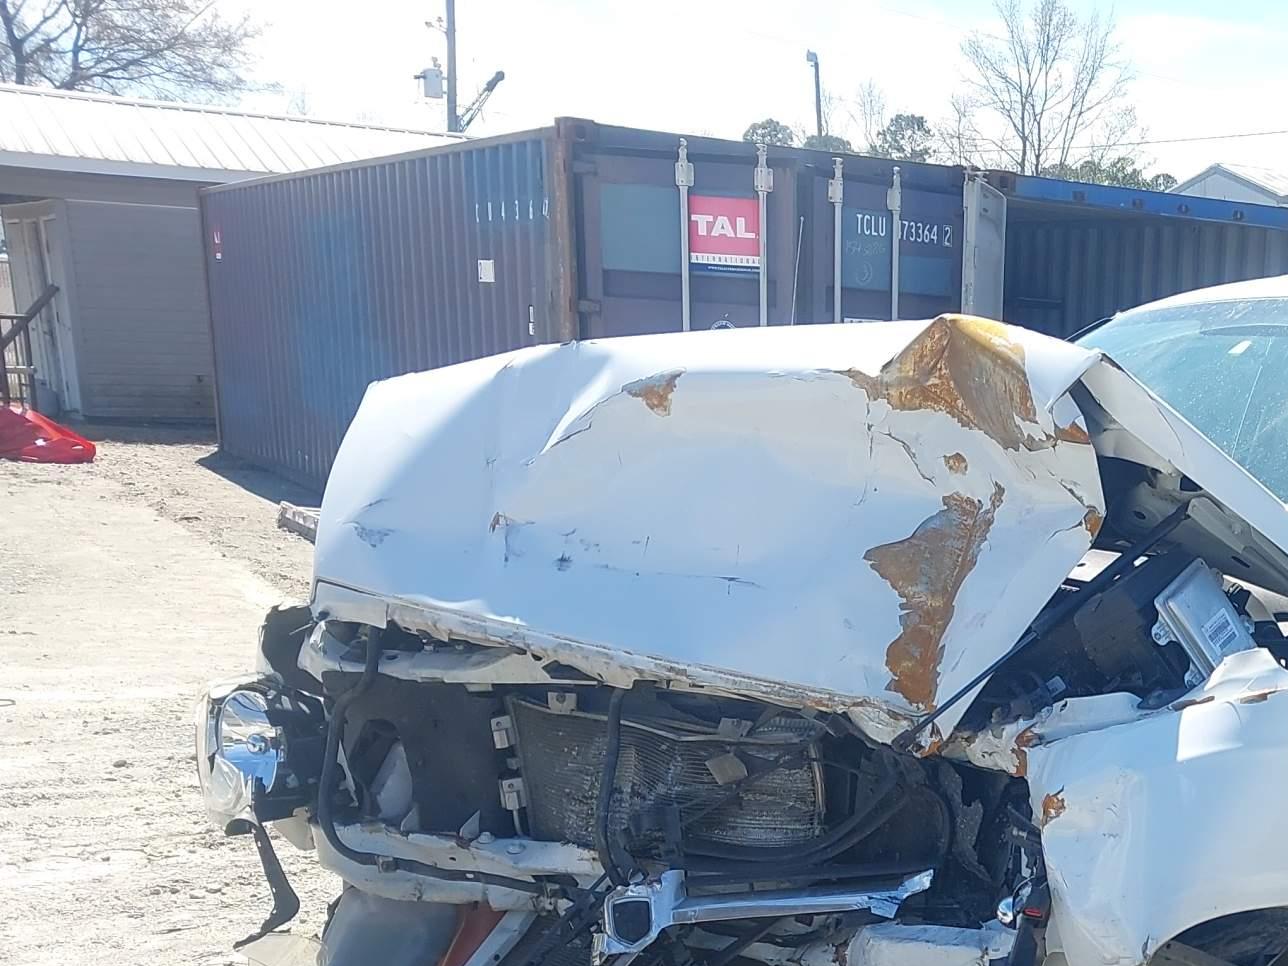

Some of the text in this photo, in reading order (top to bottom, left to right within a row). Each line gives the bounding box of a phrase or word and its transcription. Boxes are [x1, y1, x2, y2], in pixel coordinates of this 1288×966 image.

[690, 213, 756, 239] TAL
[856, 213, 886, 237] TCLU
[943, 226, 952, 247] 2
